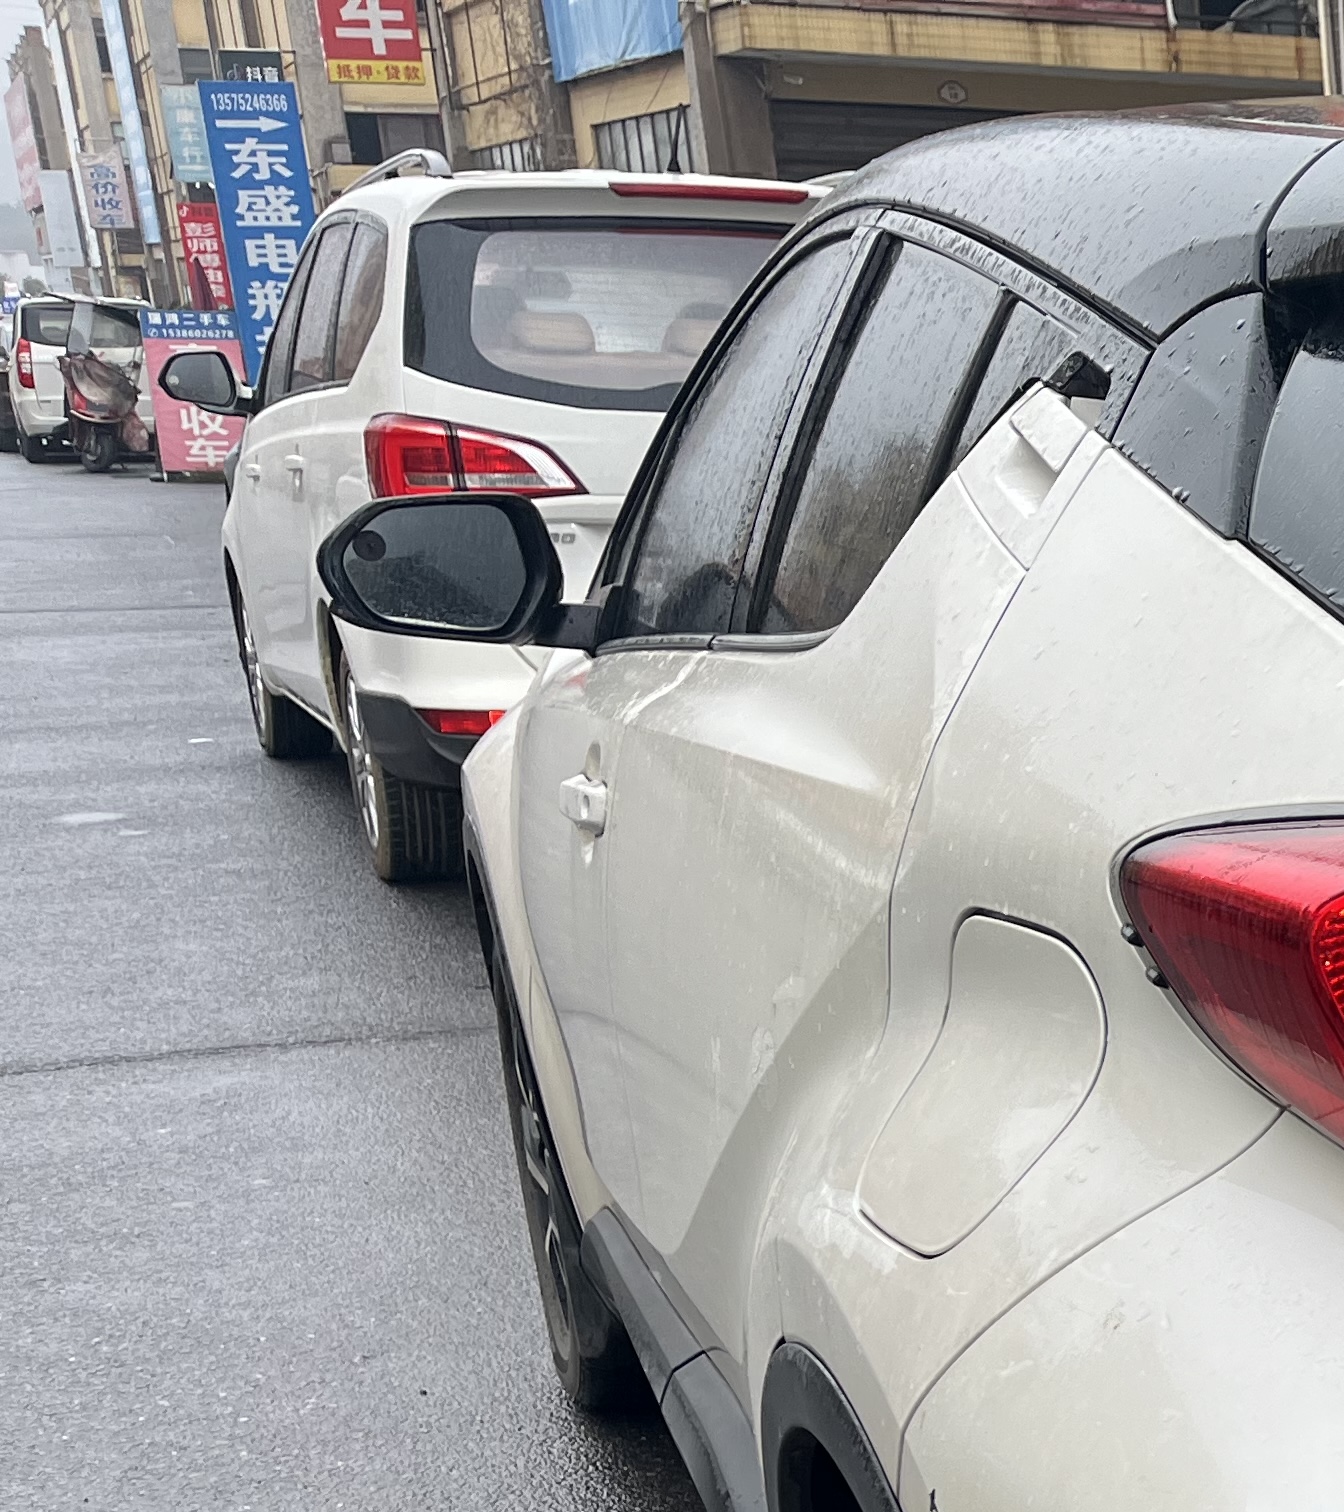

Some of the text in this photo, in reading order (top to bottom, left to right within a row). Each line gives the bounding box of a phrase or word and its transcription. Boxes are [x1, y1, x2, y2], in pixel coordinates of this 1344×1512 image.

[335, 0, 413, 55] 车
[210, 93, 288, 112] 13575246366
[90, 163, 125, 227] 高价收车
